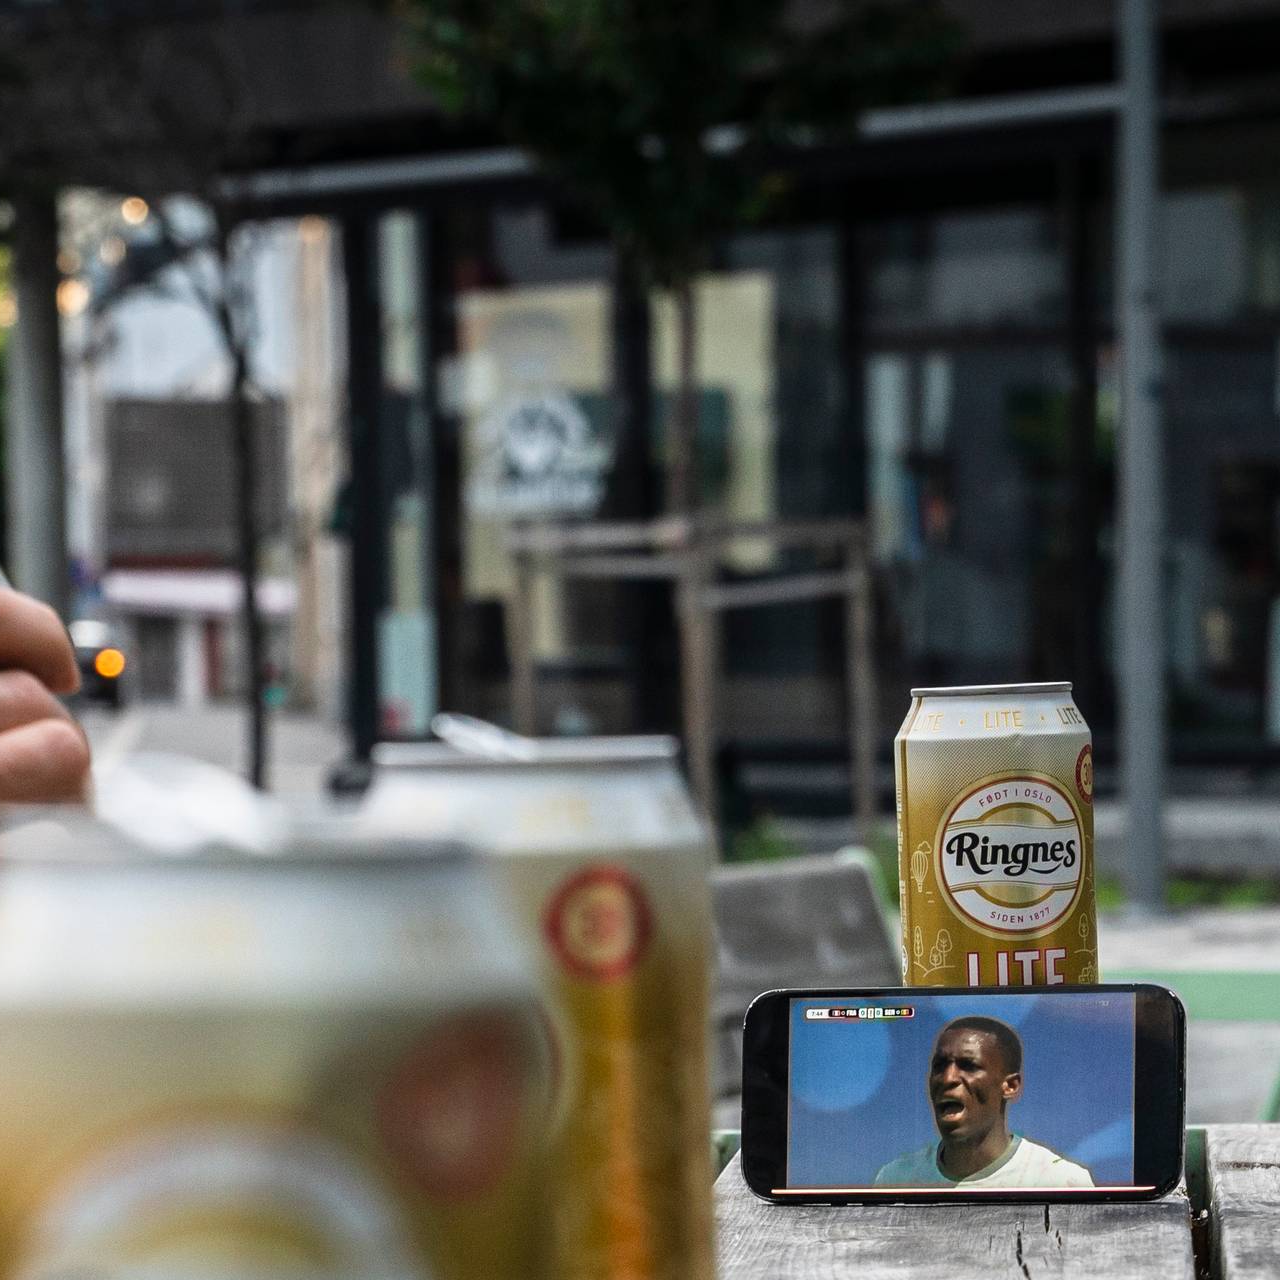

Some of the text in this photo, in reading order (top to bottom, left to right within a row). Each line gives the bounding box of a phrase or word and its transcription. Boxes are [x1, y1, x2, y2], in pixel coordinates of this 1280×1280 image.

[914, 708, 1083, 731] LITE LITE LITE
[978, 789, 1010, 808] FØDT
[1024, 788, 1053, 804] OSLO
[945, 832, 1076, 877] Ringnes
[989, 906, 1051, 924] SIDEN 1877
